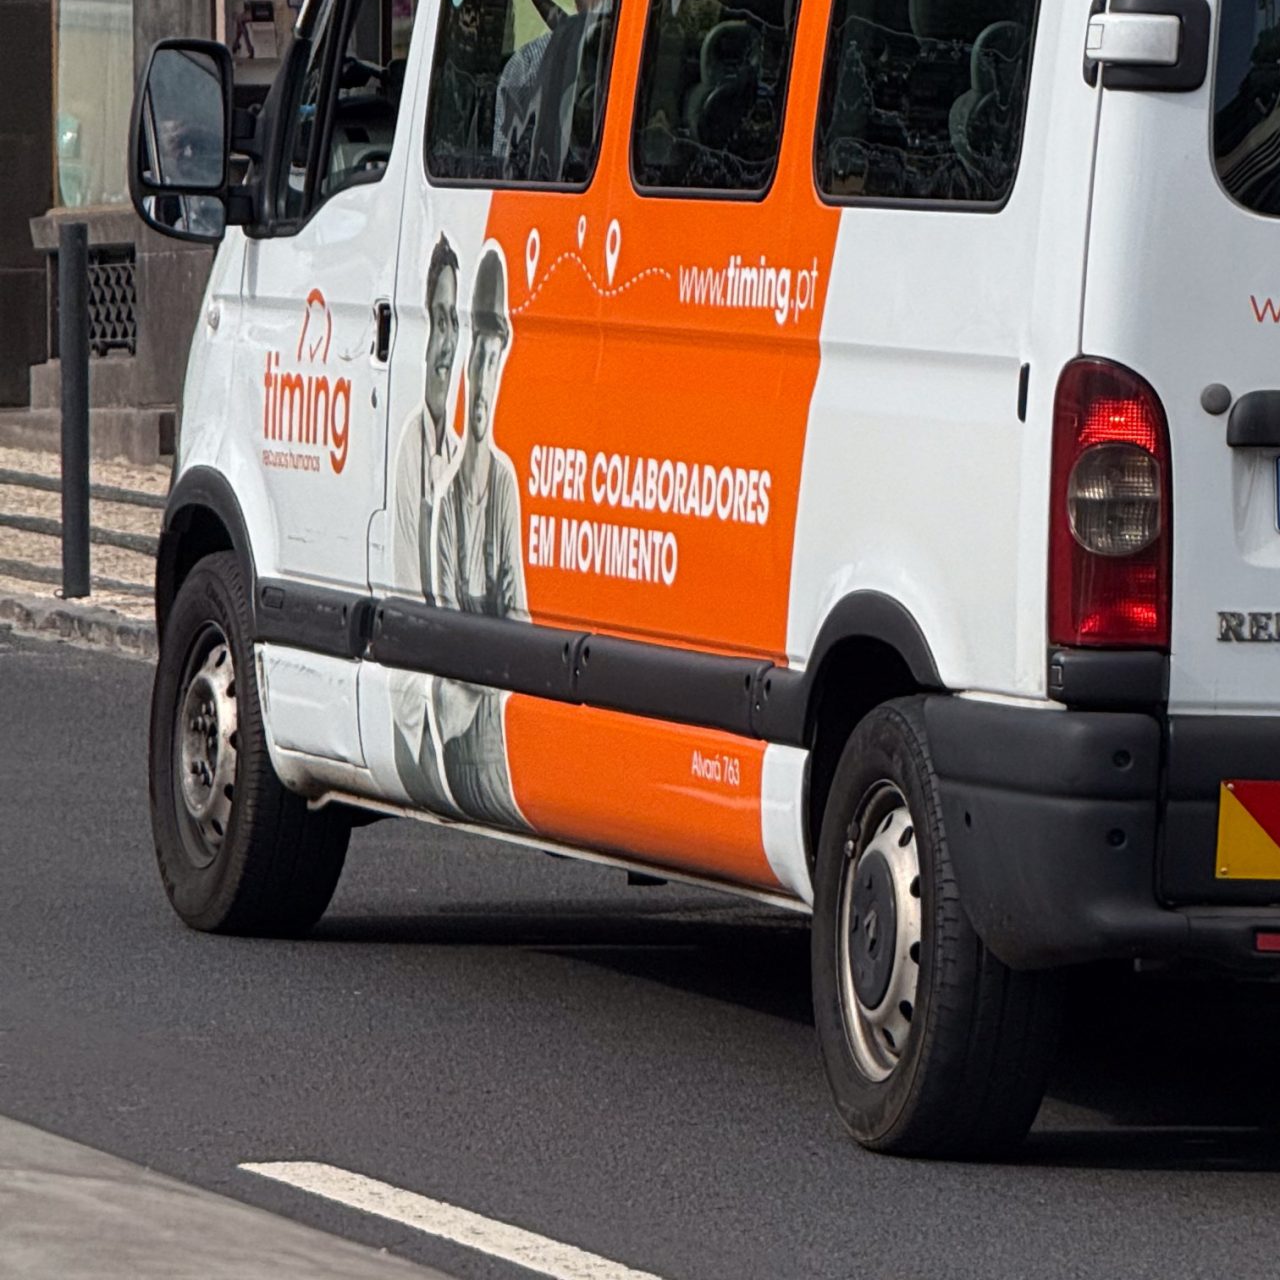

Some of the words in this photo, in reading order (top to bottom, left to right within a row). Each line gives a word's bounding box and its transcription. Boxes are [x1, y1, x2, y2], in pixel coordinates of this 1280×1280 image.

[678, 256, 819, 325] www.timing.pt
[263, 350, 352, 475] timing
[262, 449, 289, 469] recursos
[289, 449, 321, 473] humanos
[528, 444, 587, 503] SUPER
[591, 451, 772, 526] COLABORADORES
[528, 514, 555, 569] EM
[560, 518, 678, 587] MOVIMENTO
[722, 755, 740, 786] 763
